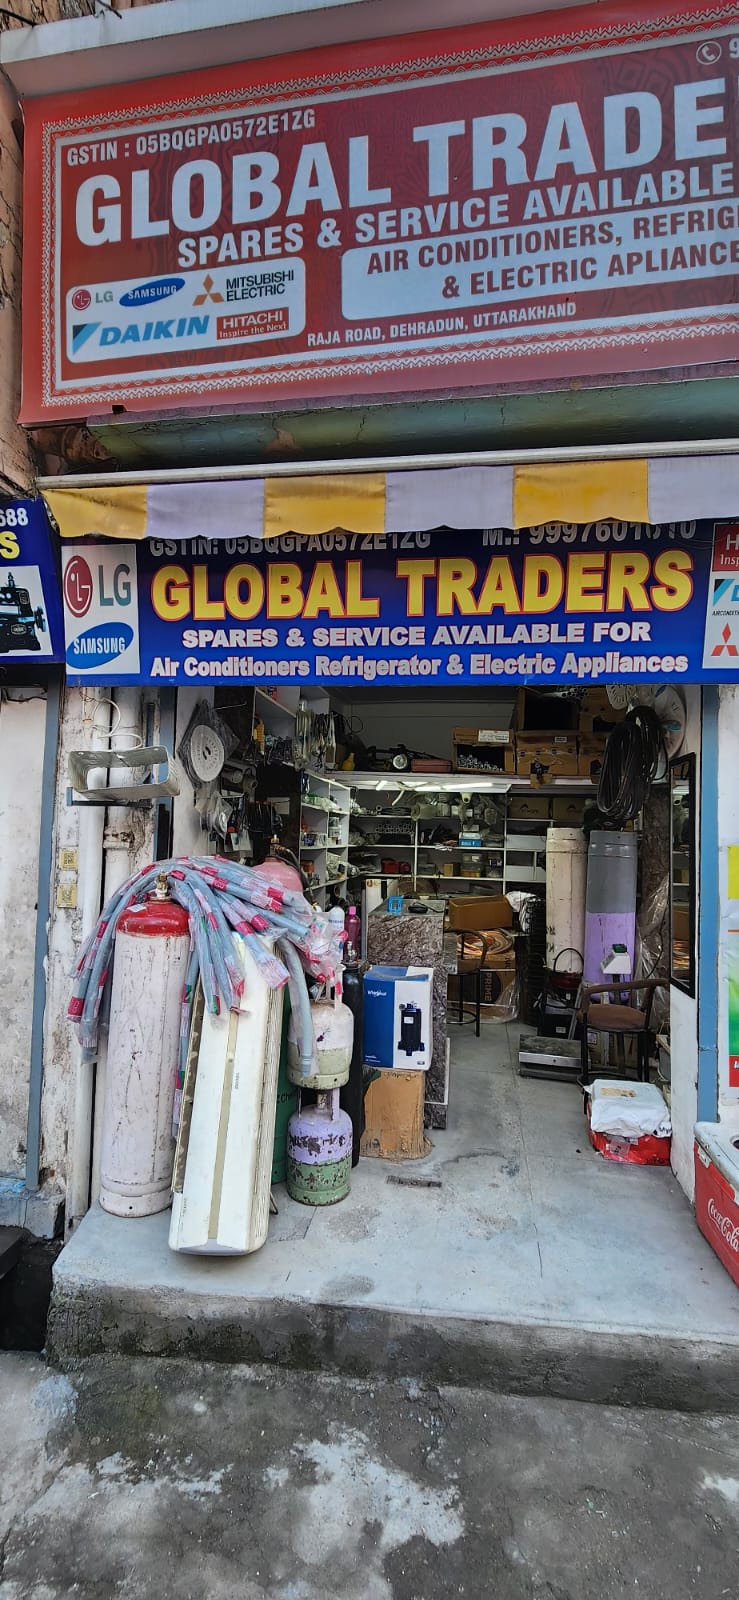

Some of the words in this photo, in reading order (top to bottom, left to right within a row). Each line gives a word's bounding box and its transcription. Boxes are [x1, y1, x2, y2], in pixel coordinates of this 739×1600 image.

[67, 141, 118, 166] GSTIN
[136, 109, 315, 156] 05BQGPA0572E1ZG
[75, 135, 391, 247] GLOBAL
[413, 75, 739, 197] TRADE
[178, 223, 303, 268] SPARES
[317, 218, 342, 249] &
[355, 194, 509, 244] SERVICE
[523, 162, 734, 220] AVAILABLE
[367, 250, 409, 275] AIR
[418, 221, 622, 268] CONDITIONERS,
[633, 204, 739, 240] REFRIG
[95, 290, 114, 304] LG
[128, 284, 178, 300] SAMSUNG
[226, 270, 294, 289] MITSUBISHI
[226, 283, 286, 302] ELECTRIC
[442, 275, 460, 299] &
[470, 257, 597, 295] ELECTRIC
[99, 315, 210, 346] DAIKIN
[222, 310, 283, 328] HITACHI
[219, 328, 249, 339] Inspire
[250, 325, 264, 334] the
[266, 321, 286, 332] Next
[307, 330, 342, 347] RAJA
[345, 323, 385, 344] ROAD,
[389, 315, 469, 340] DEHRADUN,
[473, 302, 577, 328] UTTARAKHAND
[98, 563, 132, 606] LG
[151, 559, 380, 621] GLOBAL
[396, 549, 694, 617] TRADERS
[73, 636, 126, 655] SAMSUNG
[182, 627, 279, 648] SPARES
[286, 628, 306, 647] &
[312, 626, 425, 647] SERVICE
[432, 623, 584, 646] AVAILABLE
[593, 621, 652, 643] FOR
[150, 656, 179, 678] Air
[184, 655, 309, 678] Conditioners
[315, 654, 441, 682] Refrigerator
[446, 655, 463, 676] &
[470, 652, 555, 676] Electric
[561, 651, 688, 679] Appliances
